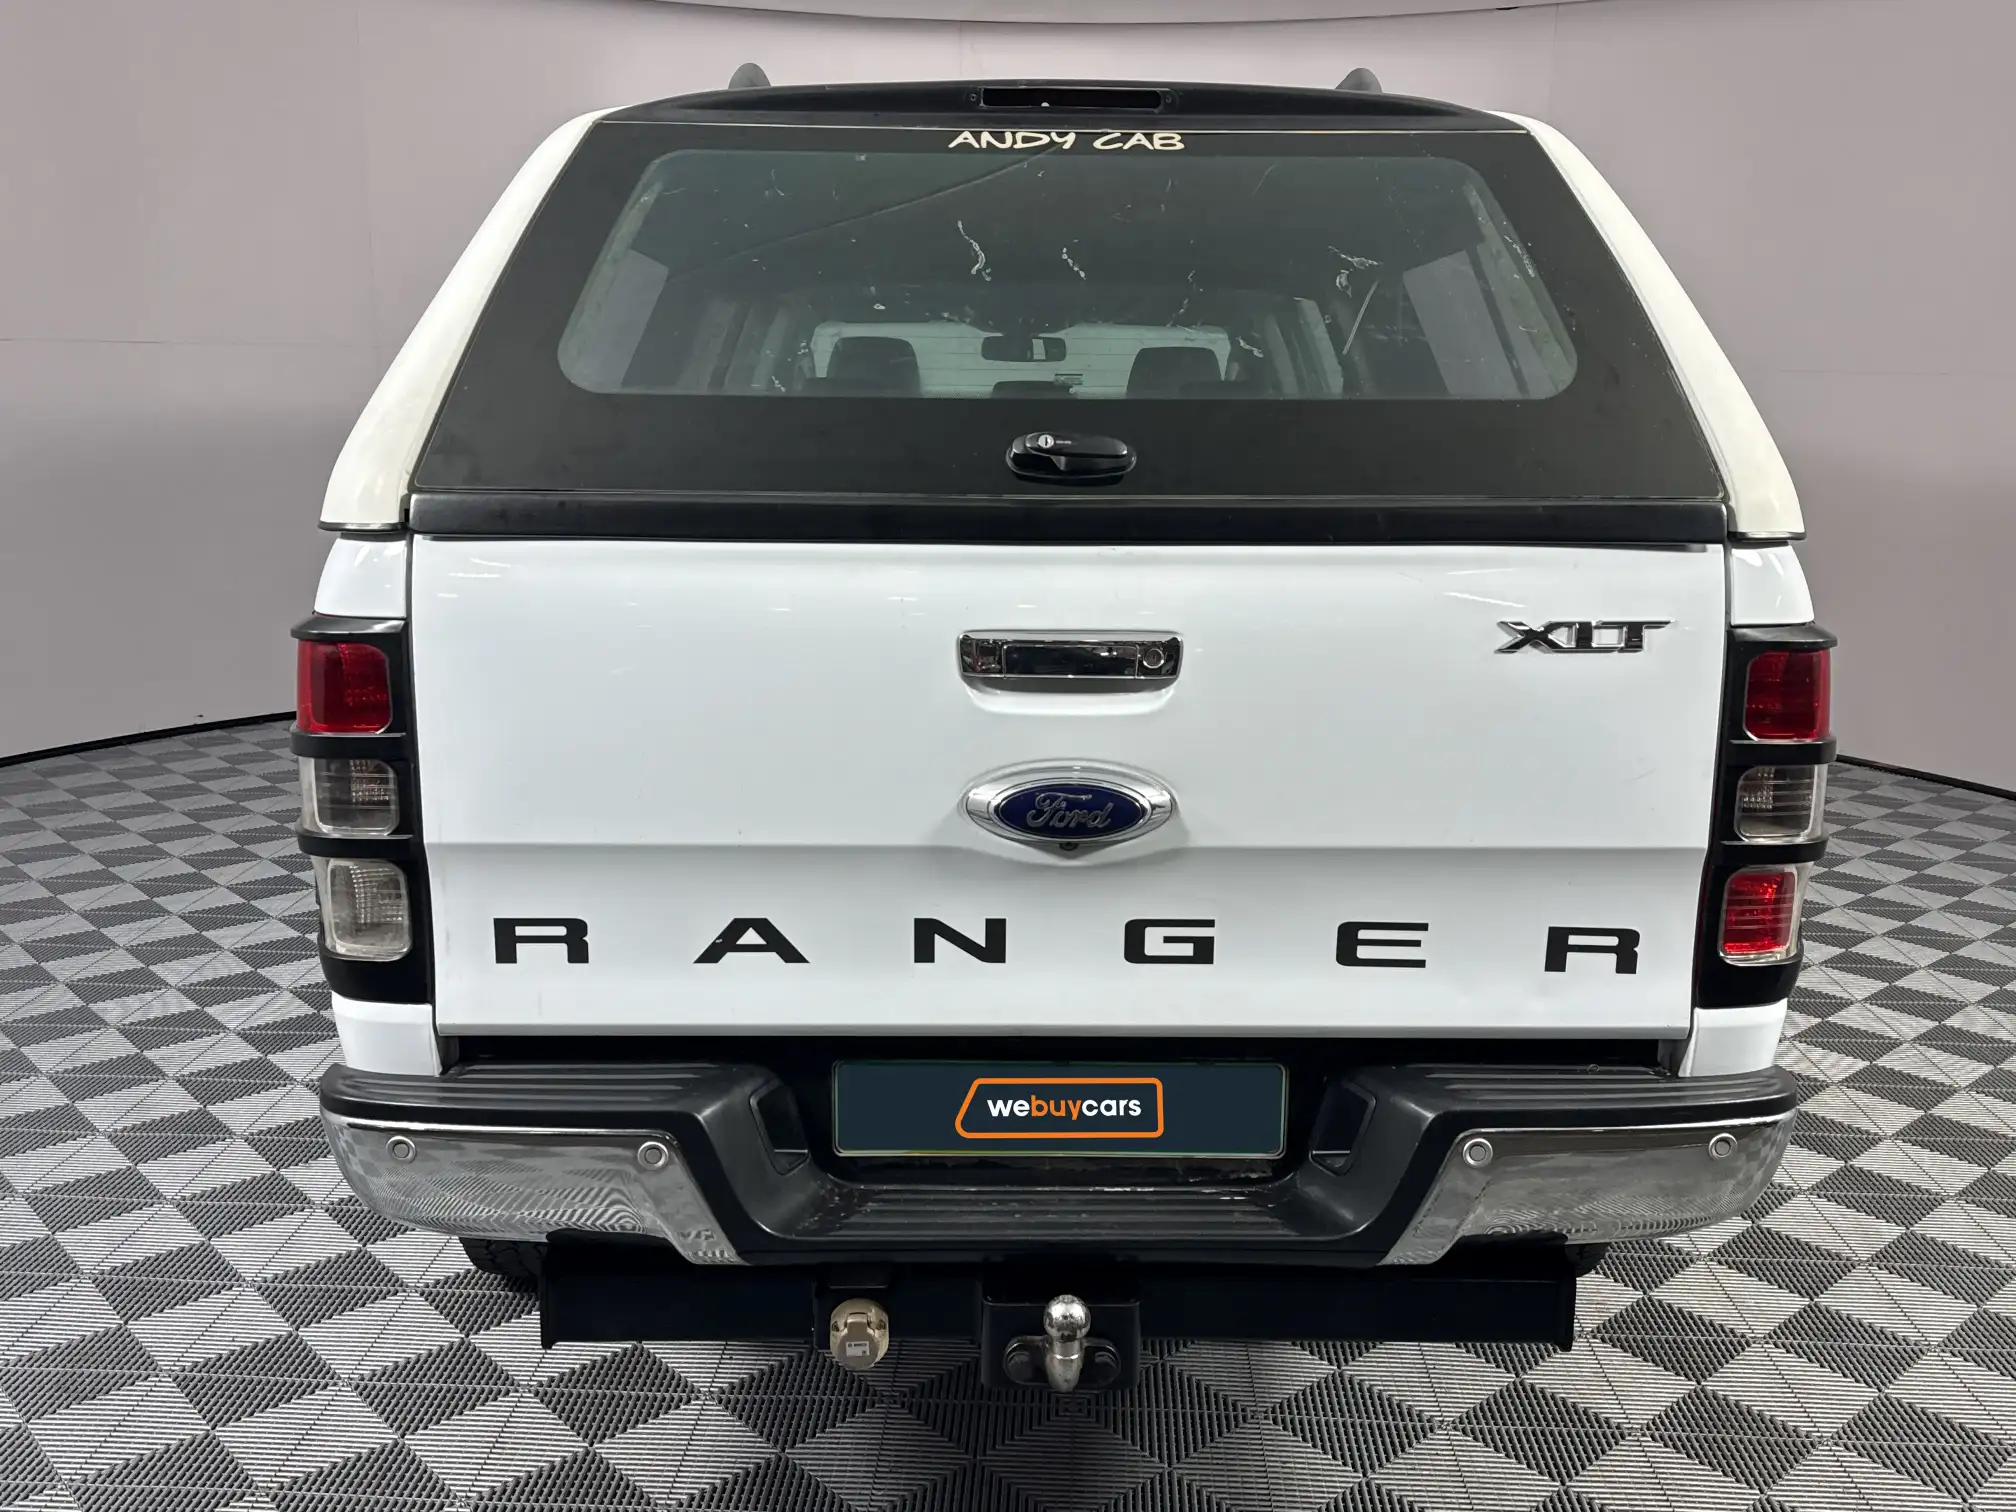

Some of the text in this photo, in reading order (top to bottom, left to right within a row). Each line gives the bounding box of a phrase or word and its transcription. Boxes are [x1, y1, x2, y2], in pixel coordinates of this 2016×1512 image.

[948, 130, 1185, 150] ANDY CAB
[1494, 620, 1675, 653] XLT
[1027, 791, 1113, 828] Ford
[493, 917, 1640, 975] RANGER
